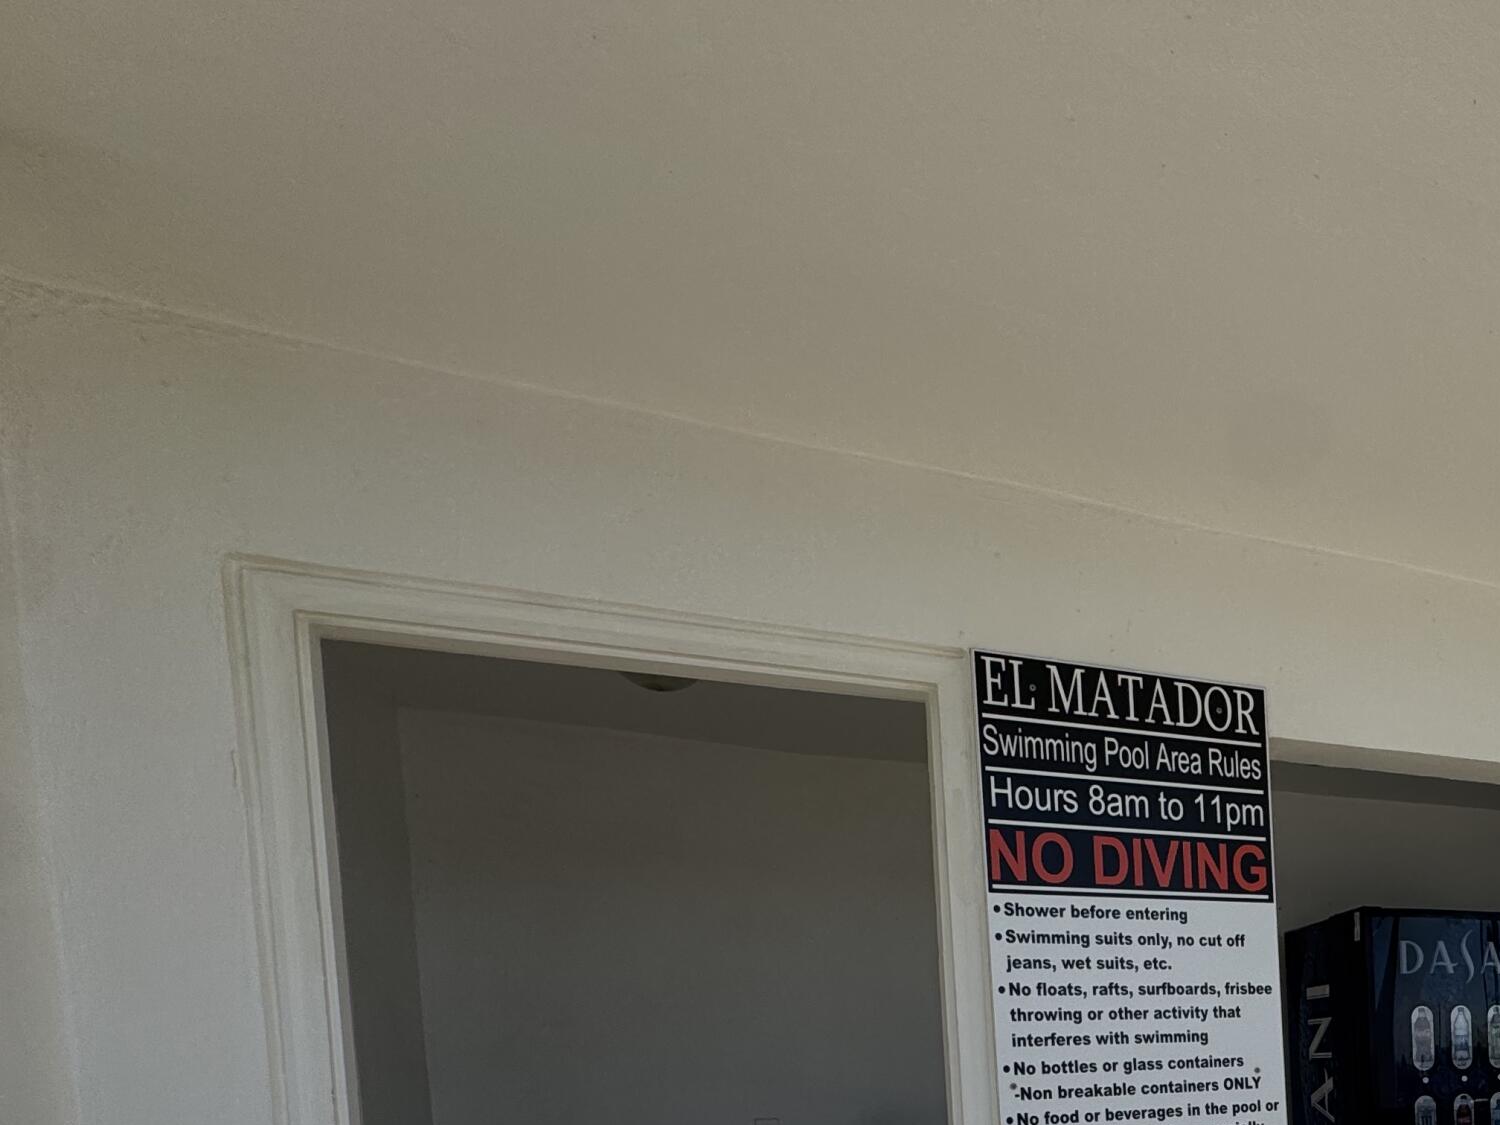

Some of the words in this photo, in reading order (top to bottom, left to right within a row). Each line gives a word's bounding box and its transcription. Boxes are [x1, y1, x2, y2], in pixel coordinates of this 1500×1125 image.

[981, 656, 1035, 710] EL
[1046, 665, 1259, 736] MATADOR
[983, 723, 1097, 772] Swimming
[1104, 737, 1149, 770] Pool
[1157, 743, 1201, 775] Area
[1208, 748, 1261, 780] Rules
[990, 775, 1078, 814] Hours
[1089, 785, 1149, 818] 8am
[1159, 792, 1184, 821] to
[1195, 794, 1264, 831] 11pm
[989, 829, 1073, 884] NO
[1093, 836, 1268, 892] DIVING
[1004, 902, 1066, 919] Shower
[1070, 904, 1120, 920] before
[1126, 908, 1188, 924] entering
[1006, 930, 1090, 948] Swimming
[1095, 933, 1132, 946] suits
[1138, 933, 1172, 949] only,
[1177, 935, 1194, 946] no
[1200, 935, 1222, 947] cut
[1226, 934, 1245, 947] off
[1006, 955, 1056, 972] jeans,
[1062, 958, 1091, 970] wet
[1096, 957, 1139, 972] suits,
[1143, 958, 1172, 970] etc.
[1009, 982, 1031, 996] No
[1036, 982, 1088, 998] floats,
[1092, 983, 1134, 998] rafts,
[1138, 982, 1221, 997] surfboards,
[1224, 982, 1272, 995] frisbee
[1010, 1008, 1082, 1024] throwing
[1088, 1009, 1102, 1020] or
[1108, 1008, 1148, 1020] other
[1154, 1006, 1208, 1021] activity
[1212, 1006, 1241, 1018] that
[1012, 1034, 1090, 1047] interferes
[1096, 1032, 1129, 1045] with
[1134, 1030, 1208, 1045] swimming
[1014, 1062, 1036, 1076] No
[1041, 1060, 1097, 1074] bottles
[1102, 1060, 1118, 1072] or
[1123, 1058, 1163, 1074] glass
[1168, 1056, 1244, 1070] containers
[1058, 1083, 1136, 1098] breakable
[1140, 1080, 1219, 1094] containers
[1223, 1076, 1262, 1090] ONLY
[1044, 1110, 1079, 1124] food
[1084, 1110, 1100, 1122] or
[1105, 1105, 1183, 1122] beverages
[1188, 1103, 1200, 1116] in
[1205, 1102, 1228, 1114] the
[1232, 1100, 1261, 1116] pool
[1266, 1100, 1280, 1112] or
